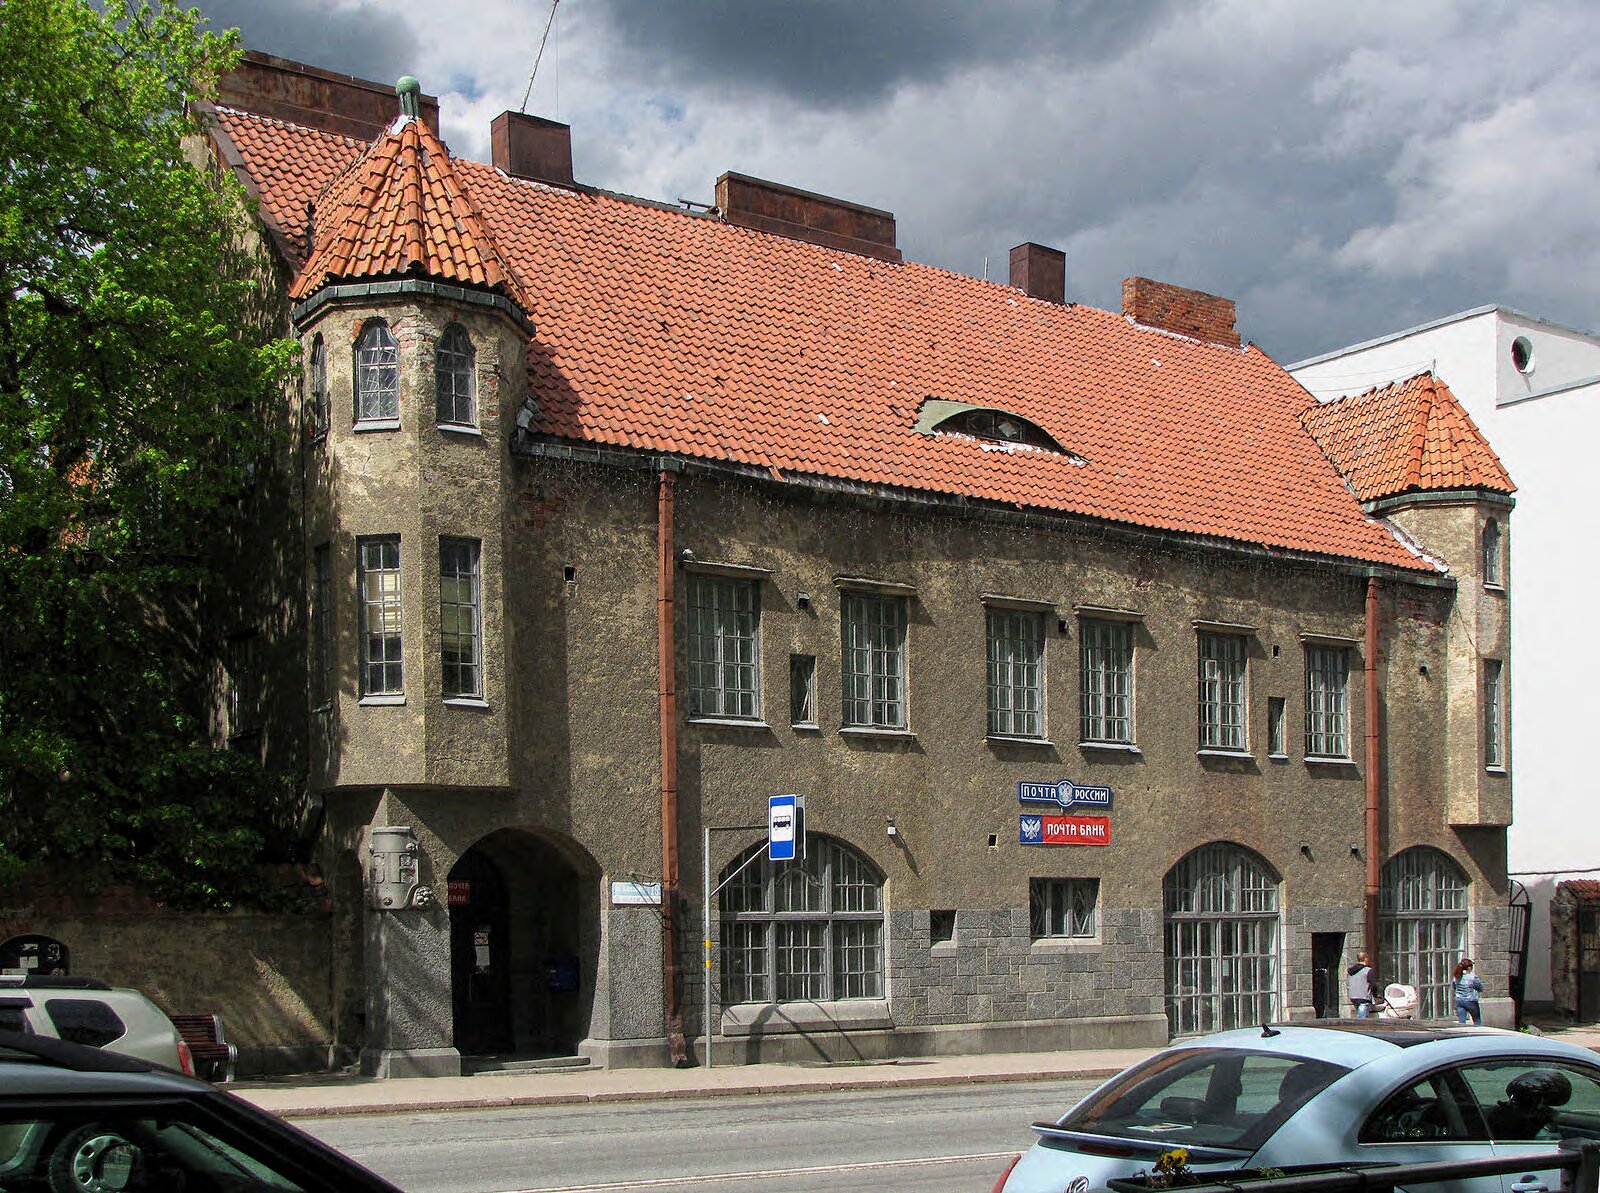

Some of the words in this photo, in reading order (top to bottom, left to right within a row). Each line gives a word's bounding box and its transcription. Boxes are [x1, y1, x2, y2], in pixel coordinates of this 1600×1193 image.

[1023, 786, 1057, 798] ПОЧТА
[1075, 789, 1107, 801] РОССИИ
[1047, 823, 1077, 836] ПОЧТА
[1079, 824, 1105, 836] БАНК
[448, 882, 470, 890] ПОЧТА
